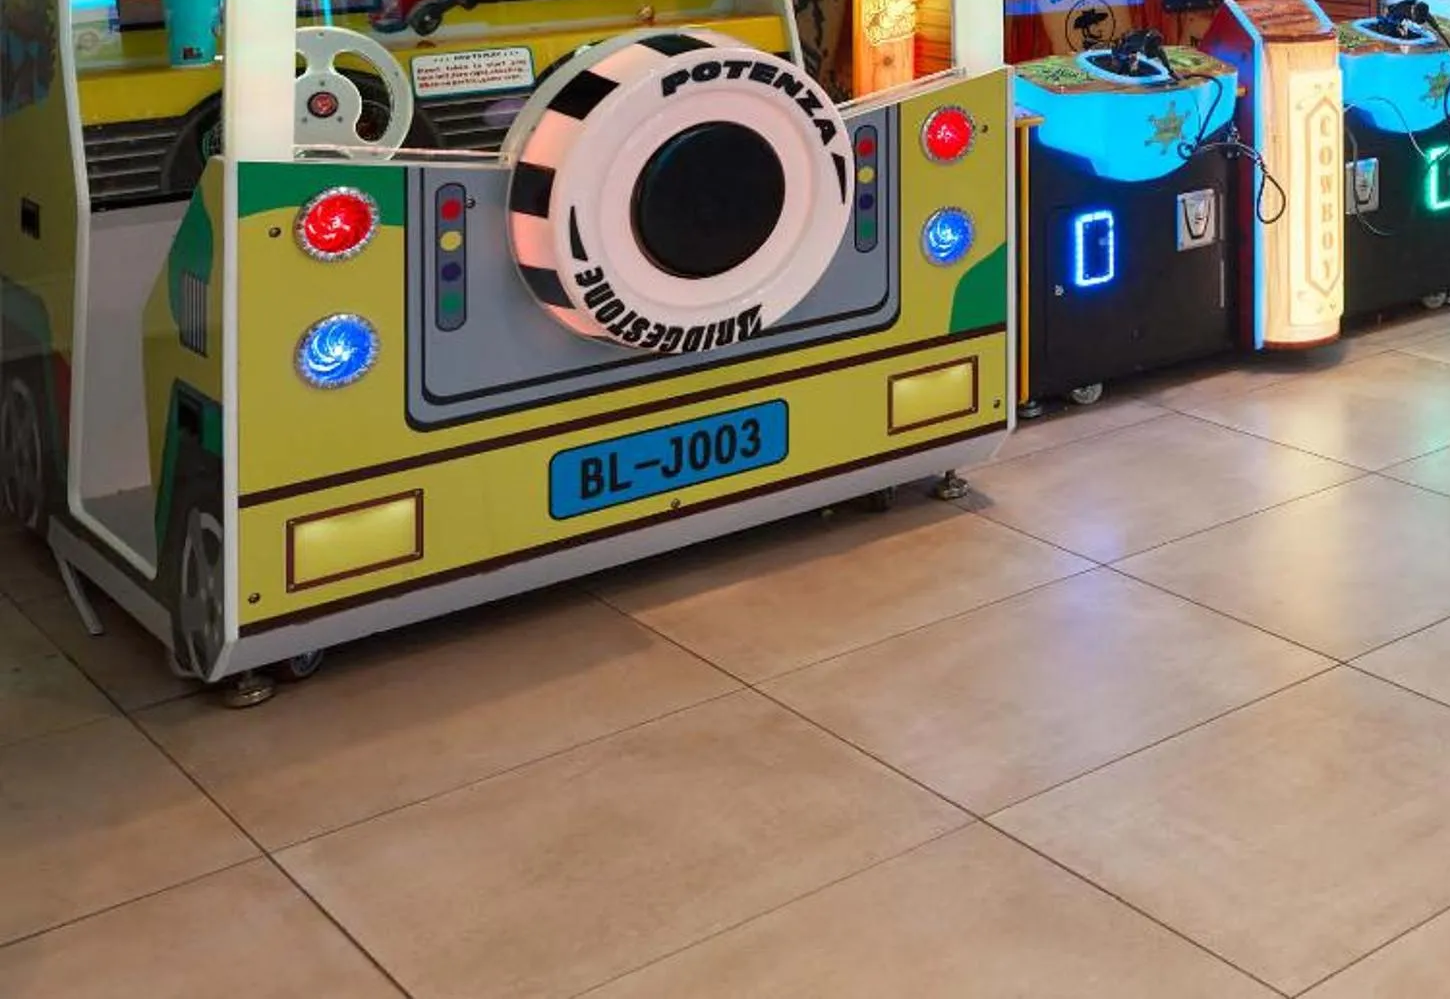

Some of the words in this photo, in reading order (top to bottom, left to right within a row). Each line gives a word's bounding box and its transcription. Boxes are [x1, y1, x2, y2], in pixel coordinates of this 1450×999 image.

[661, 60, 838, 147] POTENZA
[574, 267, 765, 353] BRIDGESTONE
[579, 417, 762, 501] BL-J003
